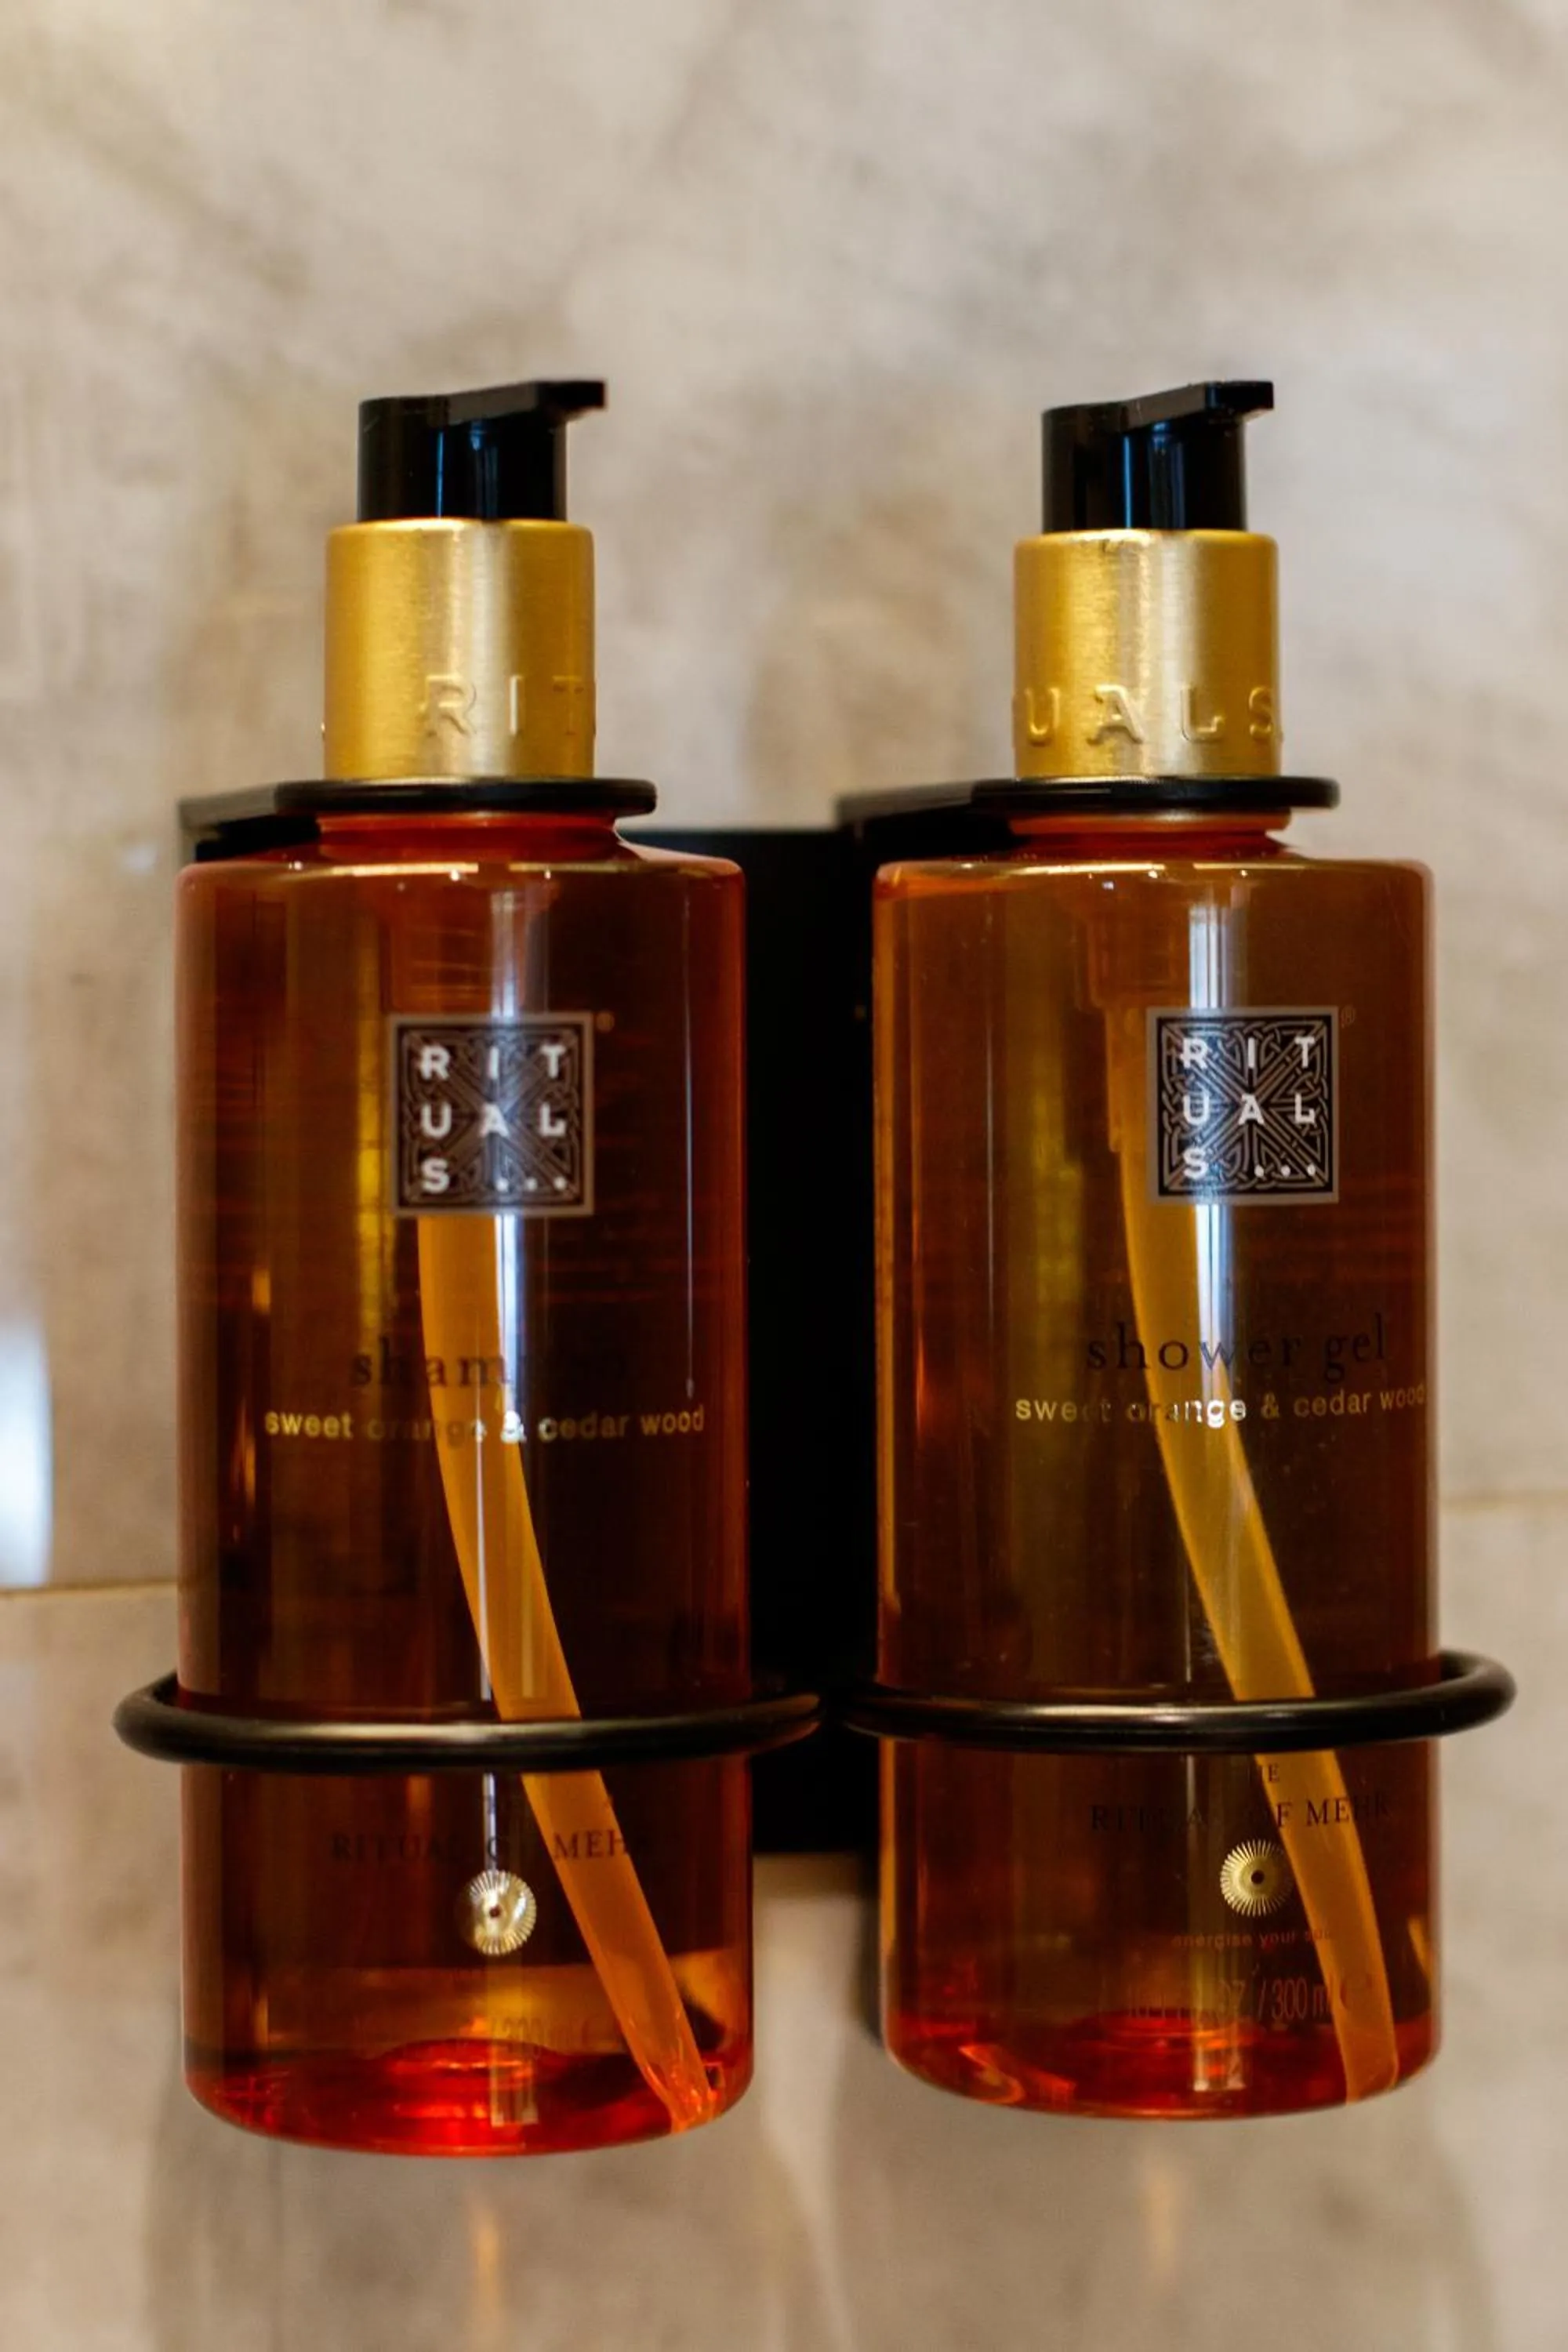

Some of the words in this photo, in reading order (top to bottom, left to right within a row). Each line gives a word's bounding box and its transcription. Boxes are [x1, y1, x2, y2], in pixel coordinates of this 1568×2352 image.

[418, 1044, 566, 1080] RIT
[1179, 1036, 1316, 1069] RIT
[419, 1102, 567, 1138] UAL
[1182, 1092, 1316, 1126] UAL
[1087, 1319, 1301, 1371] shower
[1325, 1311, 1386, 1385] gel
[1261, 1390, 1280, 1419] &
[1294, 1388, 1372, 1418] cedar
[264, 1410, 354, 1441] sweet
[500, 1410, 526, 1444] &
[538, 1410, 630, 1444] cedar
[640, 1403, 705, 1436] wood
[1270, 1976, 1308, 2022] 300
